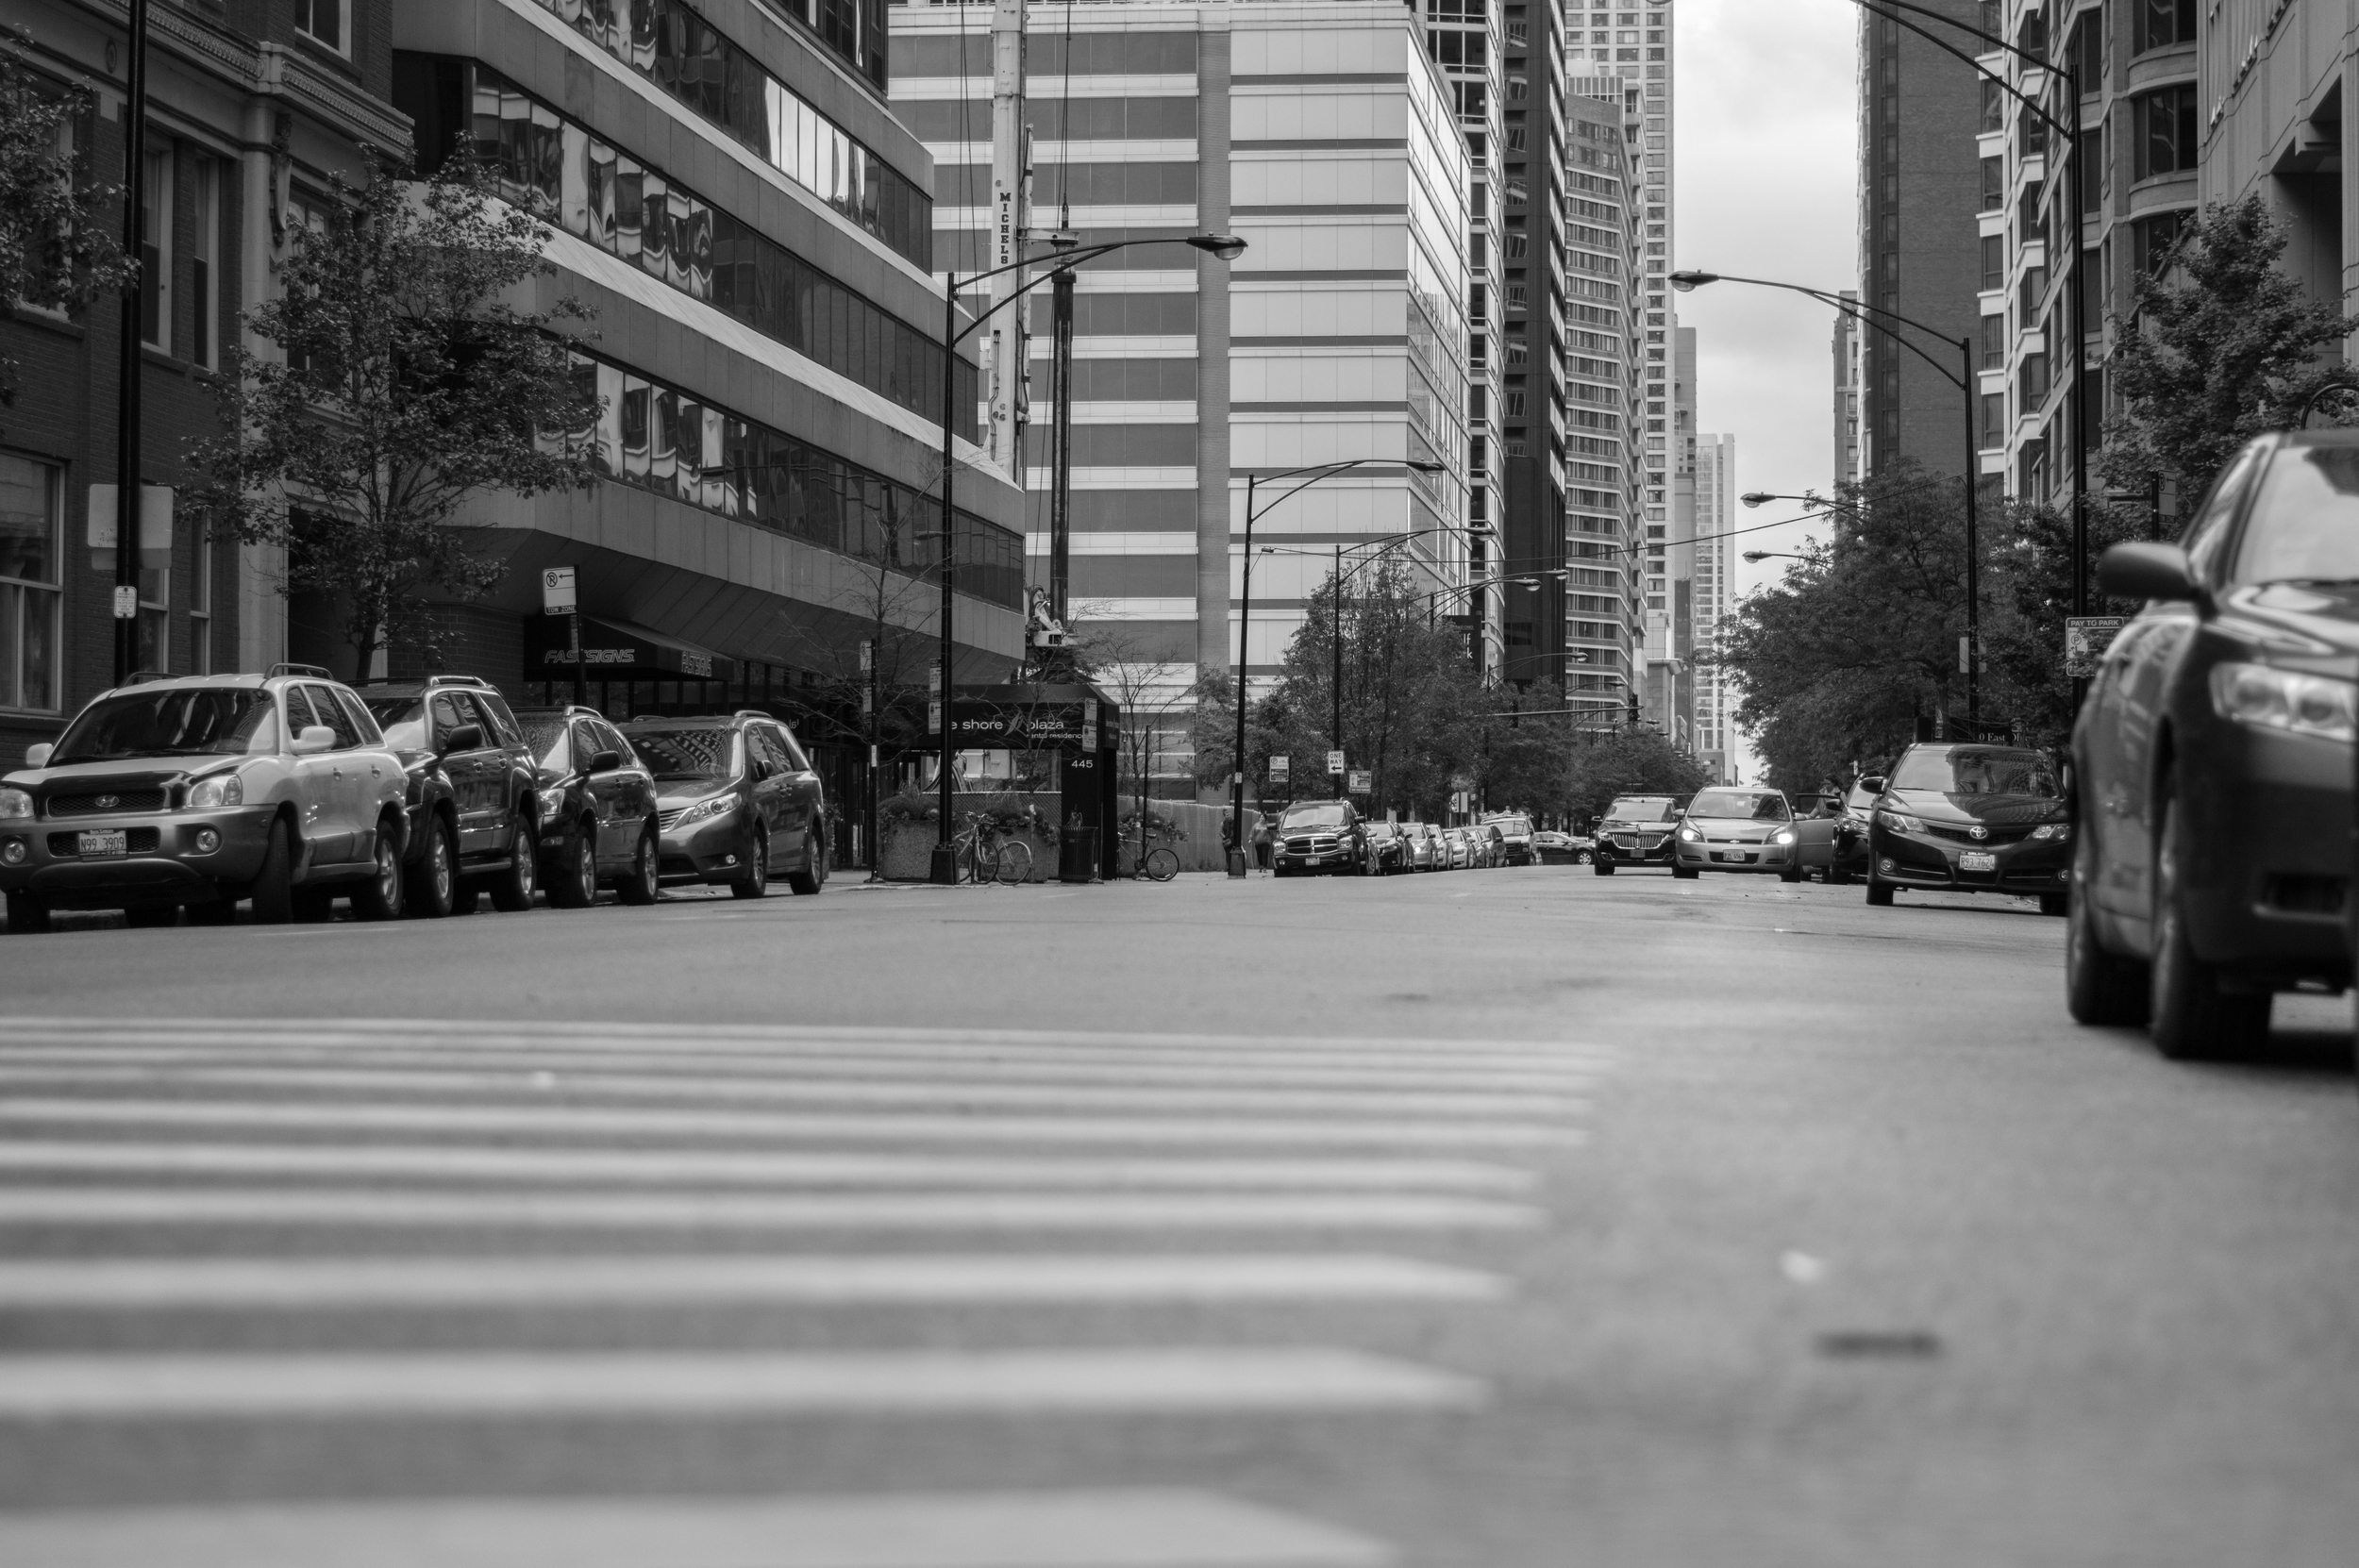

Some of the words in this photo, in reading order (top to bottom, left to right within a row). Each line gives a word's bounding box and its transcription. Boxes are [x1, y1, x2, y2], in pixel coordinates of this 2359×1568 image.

[1000, 192, 1012, 264] MICHELS
[962, 718, 1004, 730] shore
[1027, 719, 1064, 733] plaza
[1988, 733, 2005, 742] East
[1071, 759, 1094, 768] 445
[82, 839, 97, 851] N99
[103, 837, 125, 850] 3909
[1962, 858, 1973, 867] R93
[1978, 859, 1994, 867] 7624
